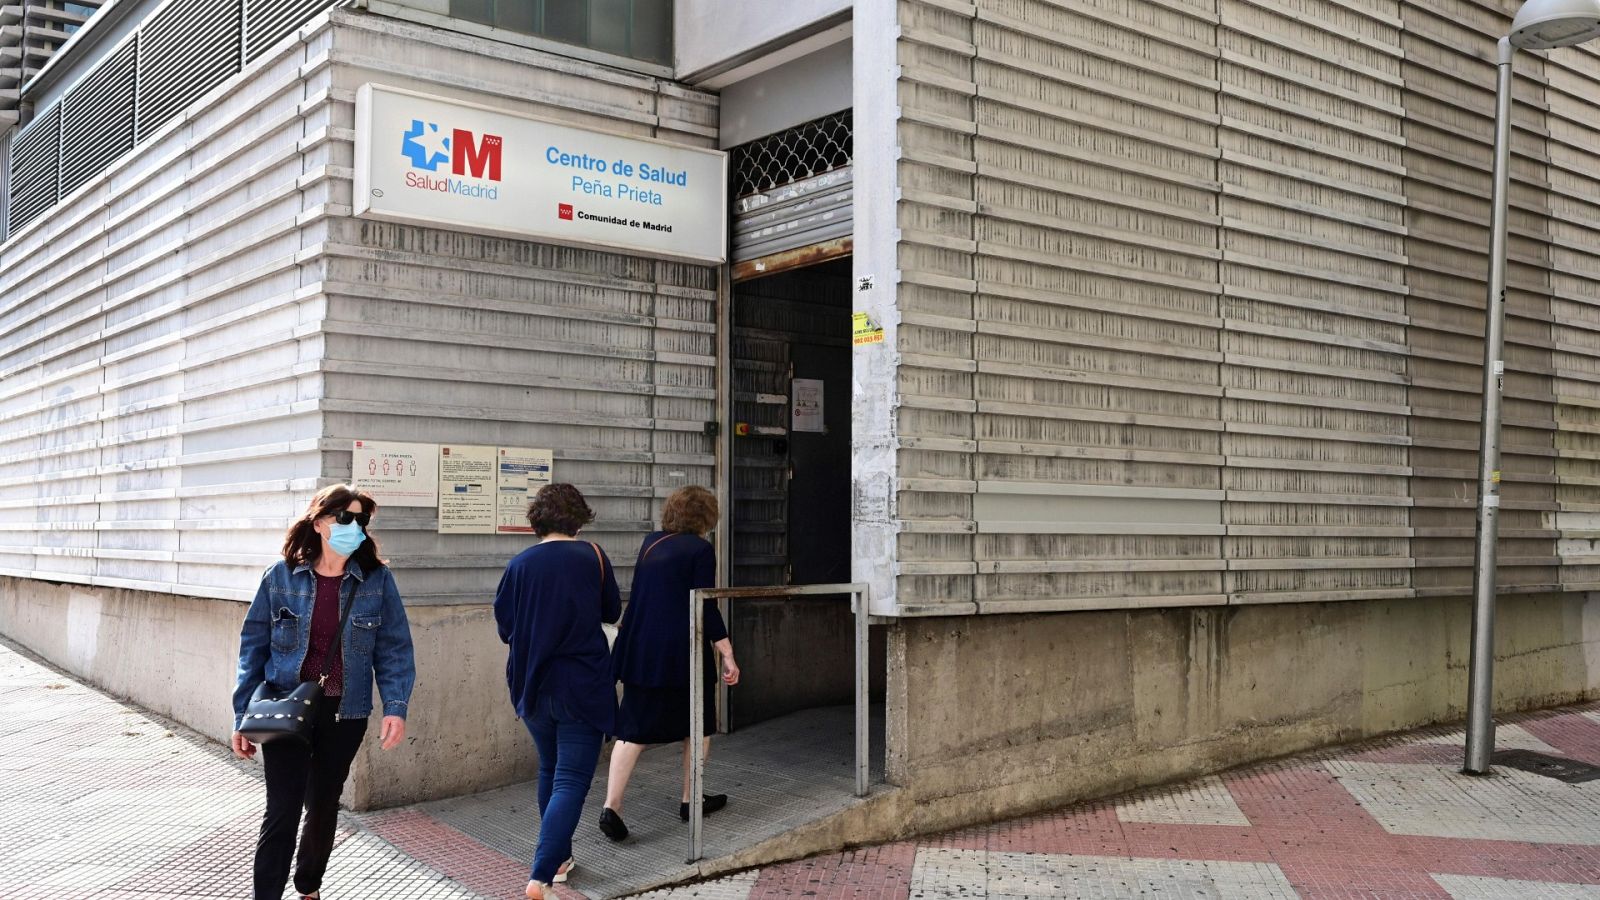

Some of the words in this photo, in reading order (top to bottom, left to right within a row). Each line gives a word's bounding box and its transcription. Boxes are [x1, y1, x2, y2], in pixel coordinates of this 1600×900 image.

[546, 147, 607, 172] Centro
[612, 160, 633, 177] de
[639, 163, 688, 186] Salud
[406, 171, 498, 200] SaludMadrid
[573, 175, 613, 198] Peña
[618, 183, 663, 206] Prieta
[577, 211, 627, 226] Comunidad
[630, 220, 641, 229] de
[643, 221, 673, 233] Madrid
